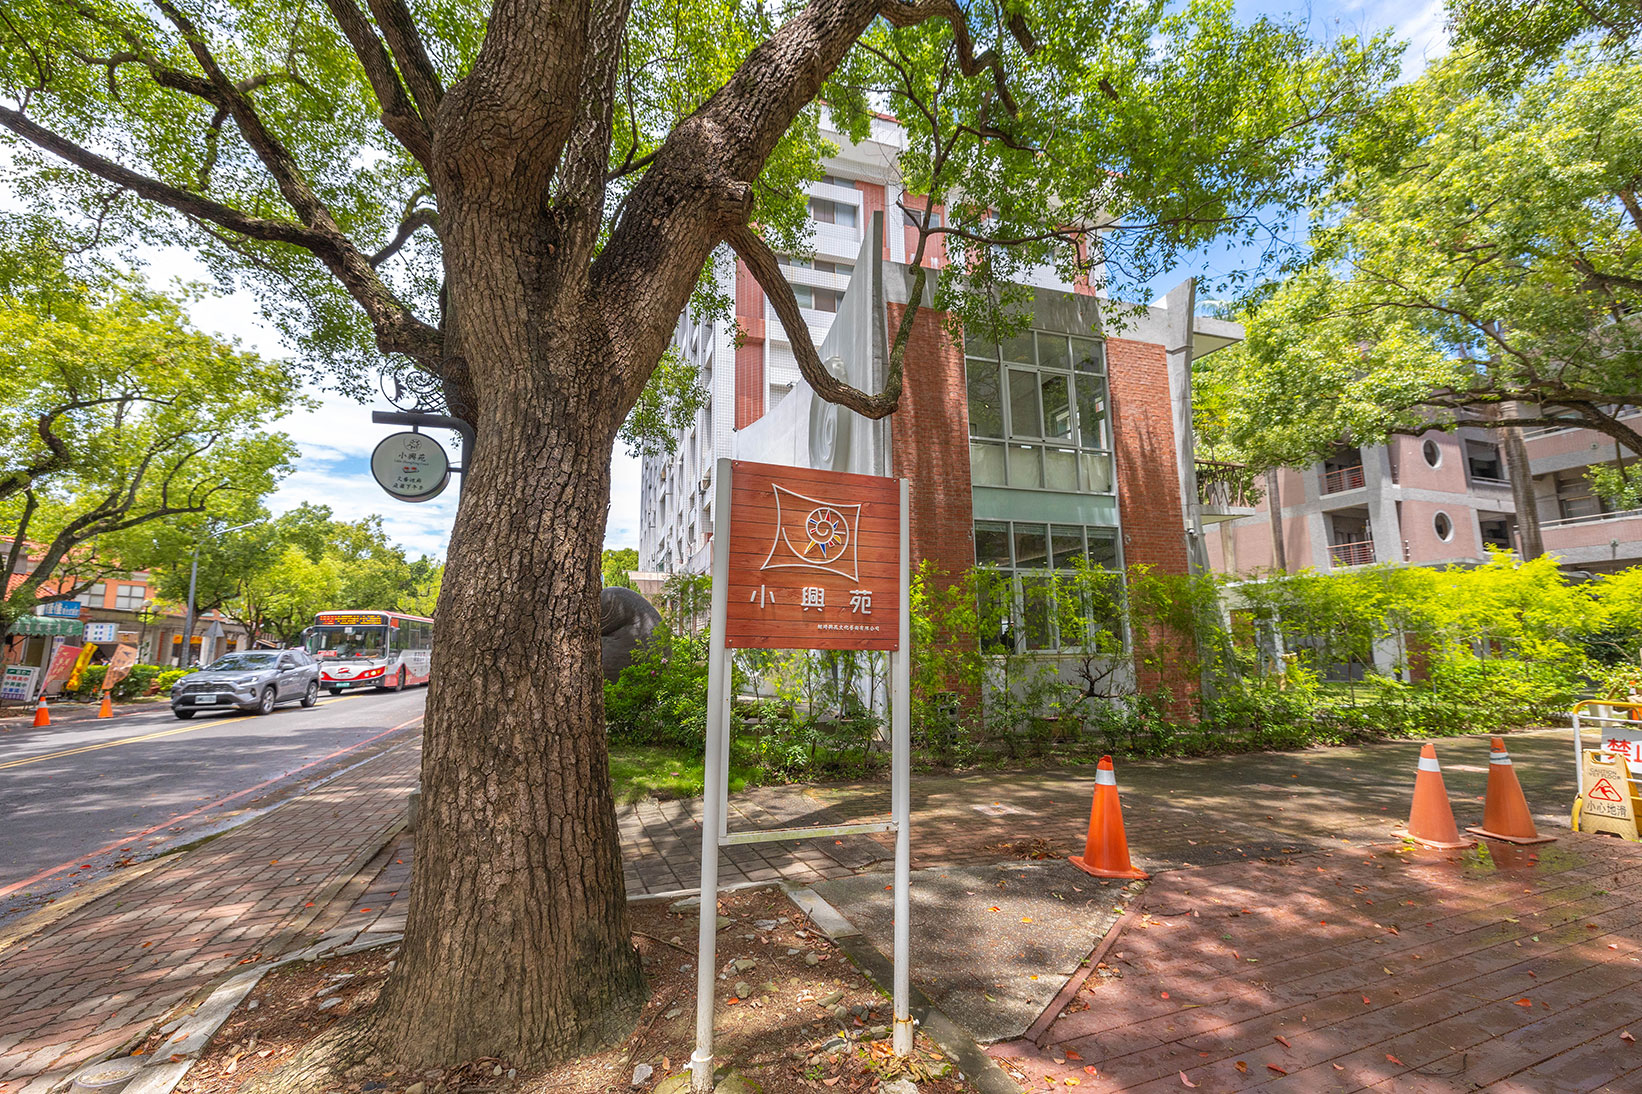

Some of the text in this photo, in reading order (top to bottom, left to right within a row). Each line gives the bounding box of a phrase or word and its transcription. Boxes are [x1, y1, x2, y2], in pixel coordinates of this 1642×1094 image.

[398, 452, 426, 462] 小興苑
[750, 584, 873, 615] 小興苑
[1590, 768, 1617, 776] CAUTION
[1587, 800, 1627, 818] 小心地滑
